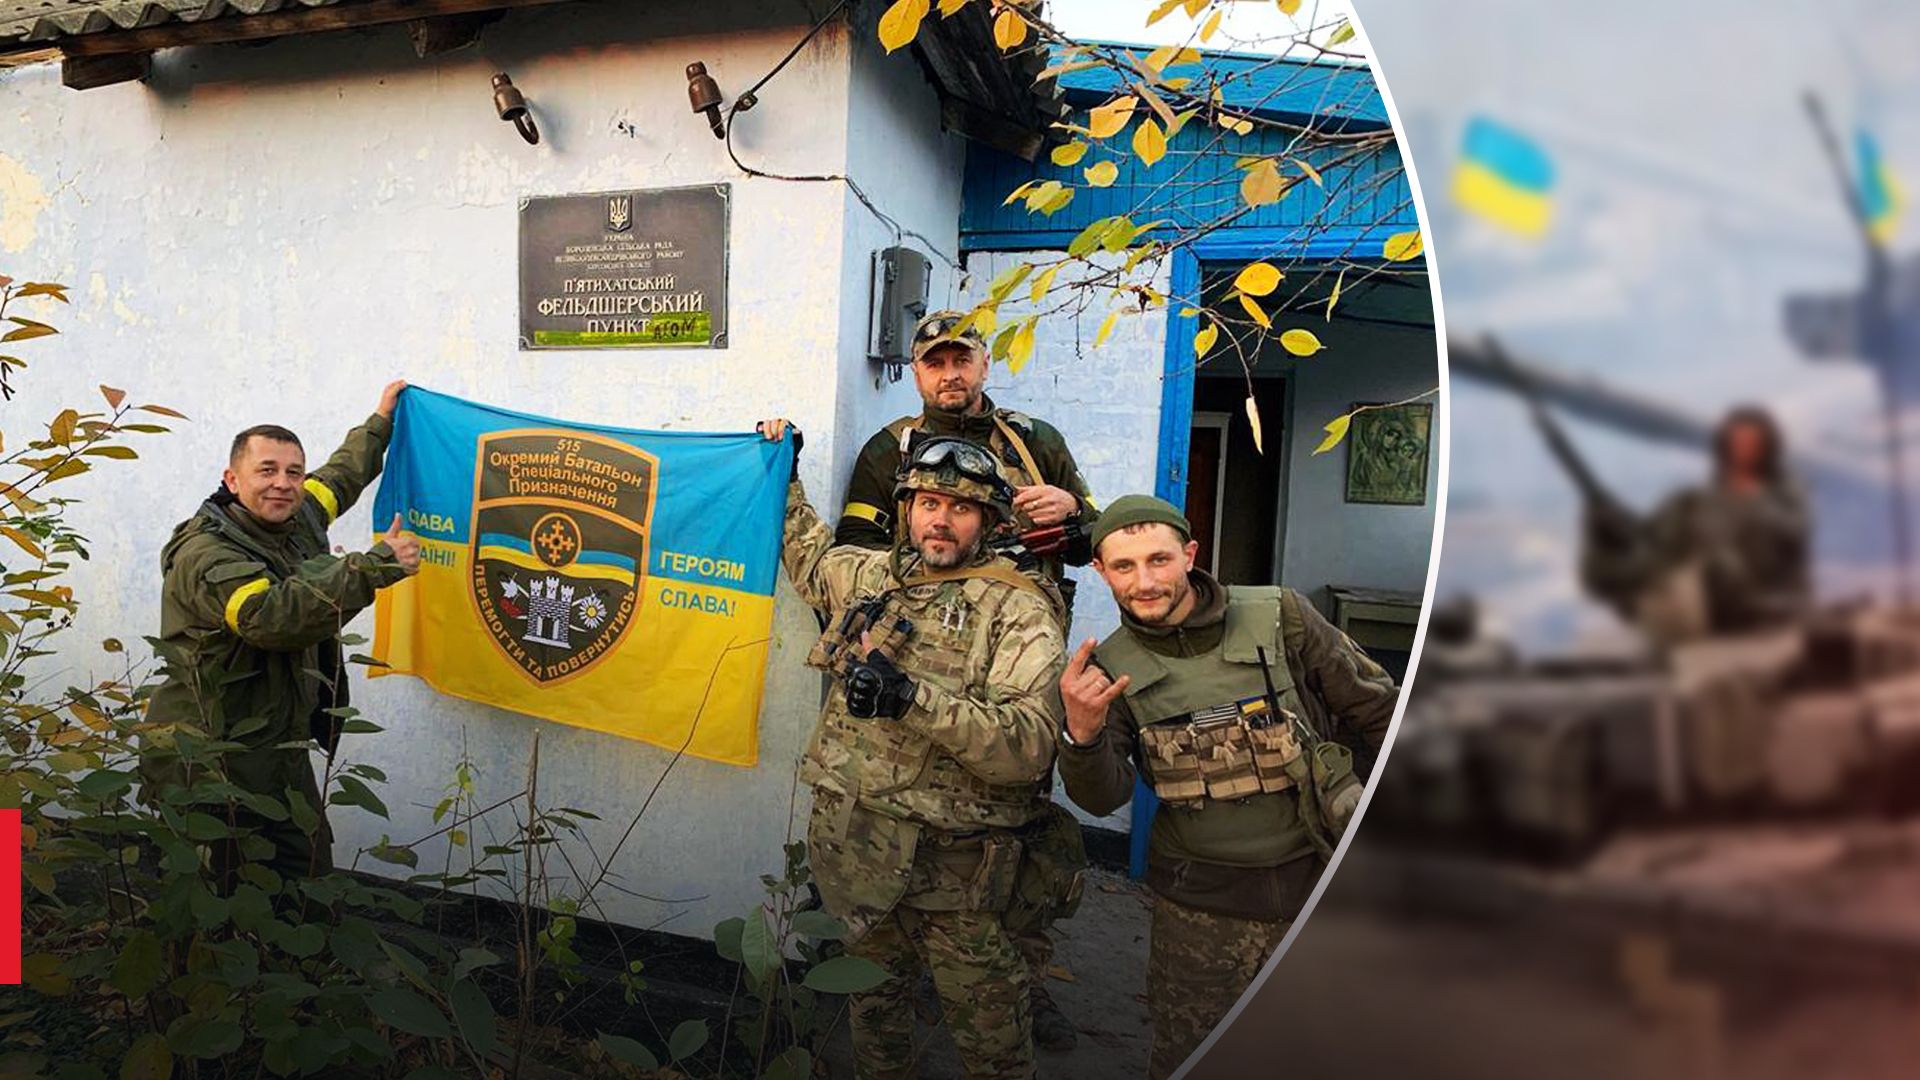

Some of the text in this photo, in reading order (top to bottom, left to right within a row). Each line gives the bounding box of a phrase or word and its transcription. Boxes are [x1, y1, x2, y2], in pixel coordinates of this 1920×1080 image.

[564, 274, 675, 293] П'ЯТИХАТСЬКИЙ
[538, 291, 703, 317] ФЕЛЬДШЕРСЬКИЙ
[587, 319, 650, 335] ПУНКТ
[556, 438, 582, 452] 515
[490, 450, 643, 487] Окремий Батальон
[510, 465, 618, 493] Спеціального
[509, 479, 618, 509] Призначення
[420, 544, 456, 568] АЇНІ!
[660, 551, 746, 582] ГЕРОЯМ
[659, 587, 737, 617] СЛАВА!
[475, 564, 636, 678] ПЕРЕМОГТИ ТА ПОВЕРНУТИСЬ
